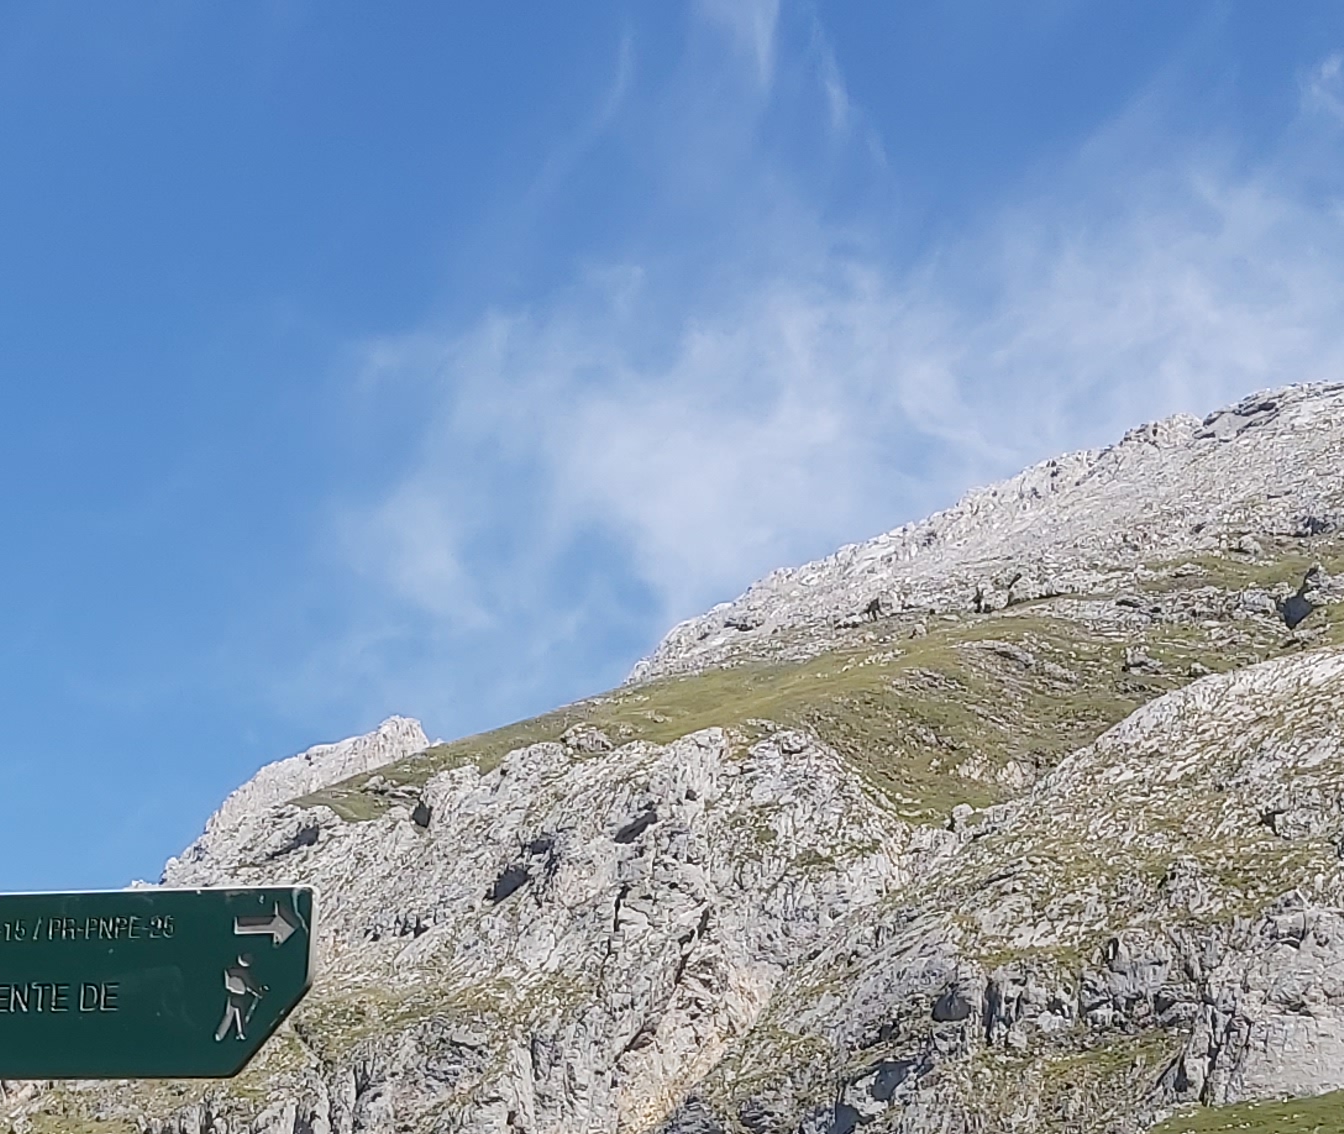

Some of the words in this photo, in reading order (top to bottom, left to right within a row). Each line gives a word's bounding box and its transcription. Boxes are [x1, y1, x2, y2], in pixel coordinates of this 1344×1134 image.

[32, 917, 43, 940] /
[48, 914, 175, 940] PR-PNPE-25
[79, 981, 121, 1012] DE
